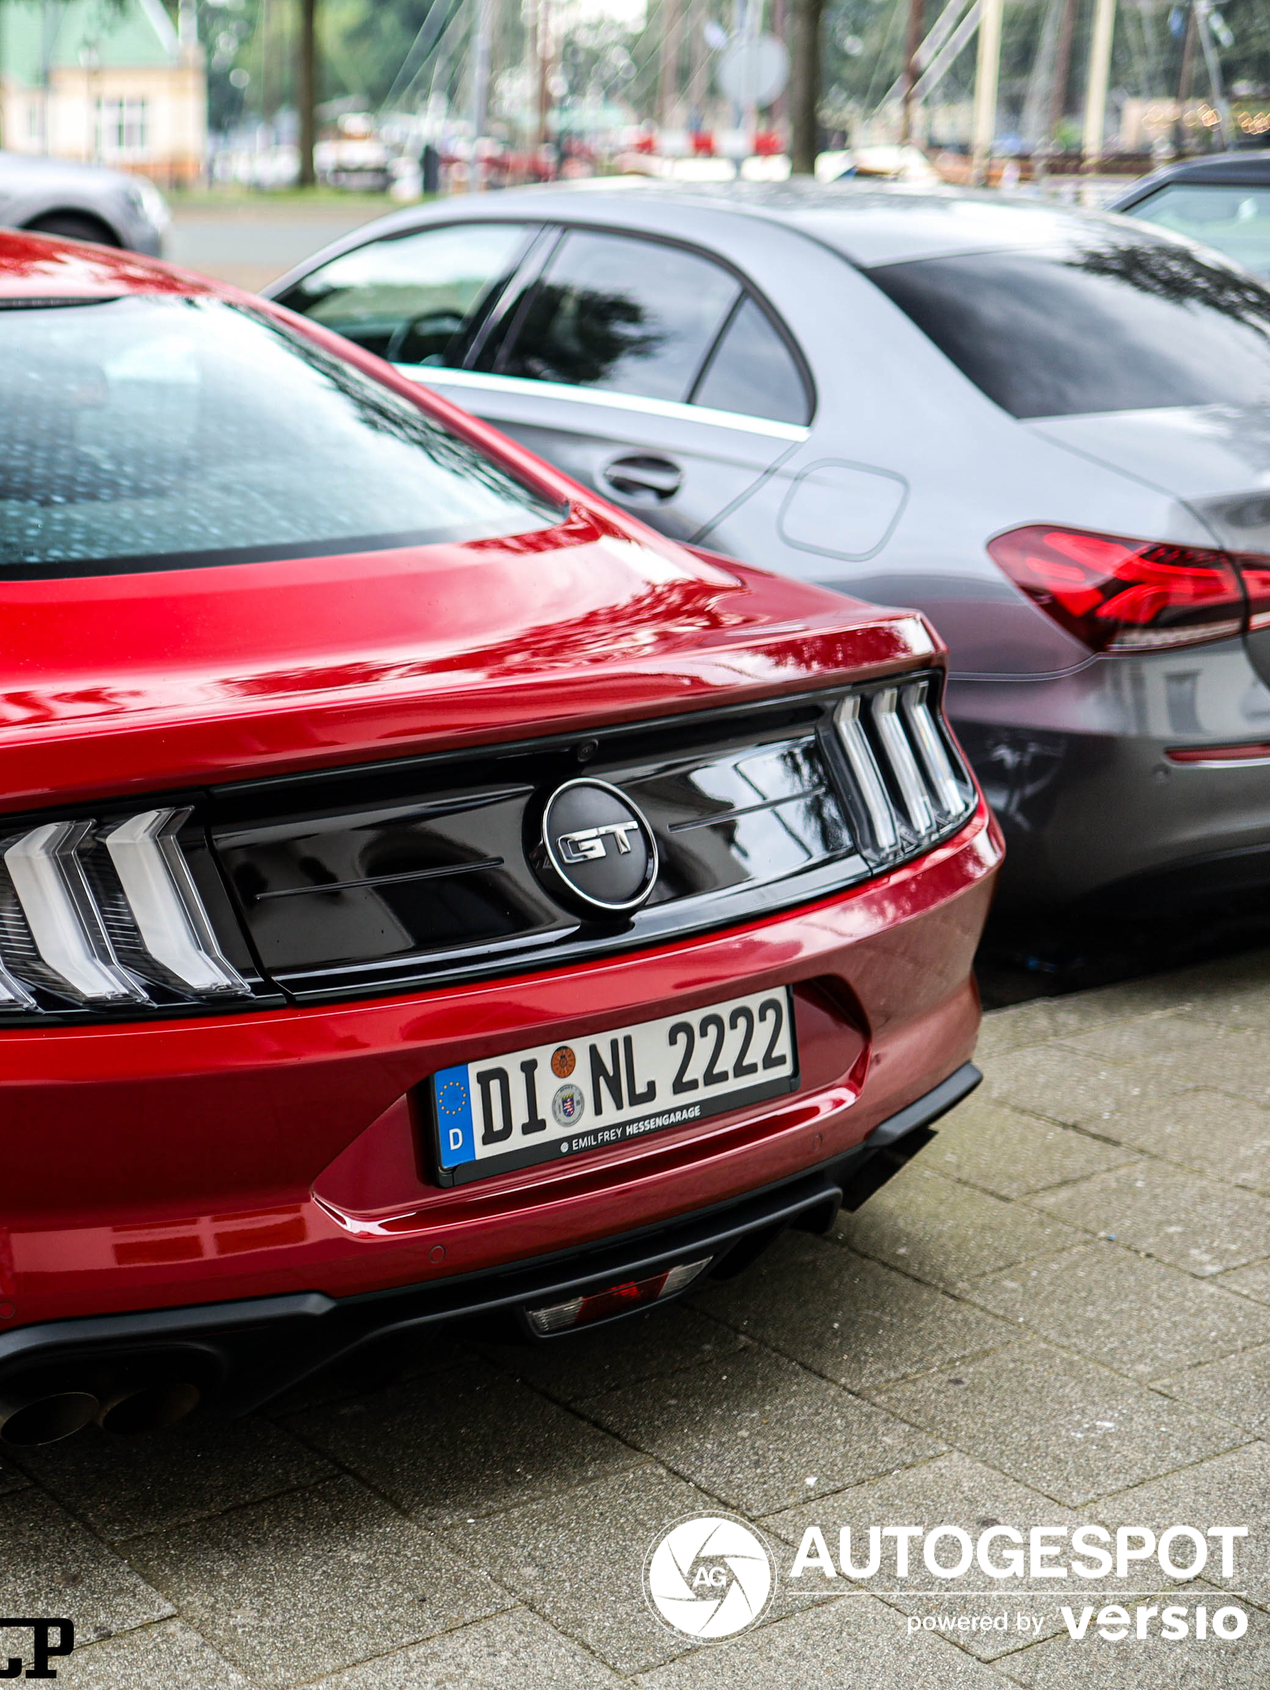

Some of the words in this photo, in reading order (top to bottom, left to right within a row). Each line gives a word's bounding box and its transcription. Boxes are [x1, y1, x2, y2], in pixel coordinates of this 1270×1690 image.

[558, 820, 639, 864] GT
[476, 1058, 547, 1146] DI
[589, 1034, 656, 1116] NL
[669, 998, 787, 1095] 2222
[449, 1127, 463, 1151] D
[626, 1105, 701, 1136] HESSENGARAGE
